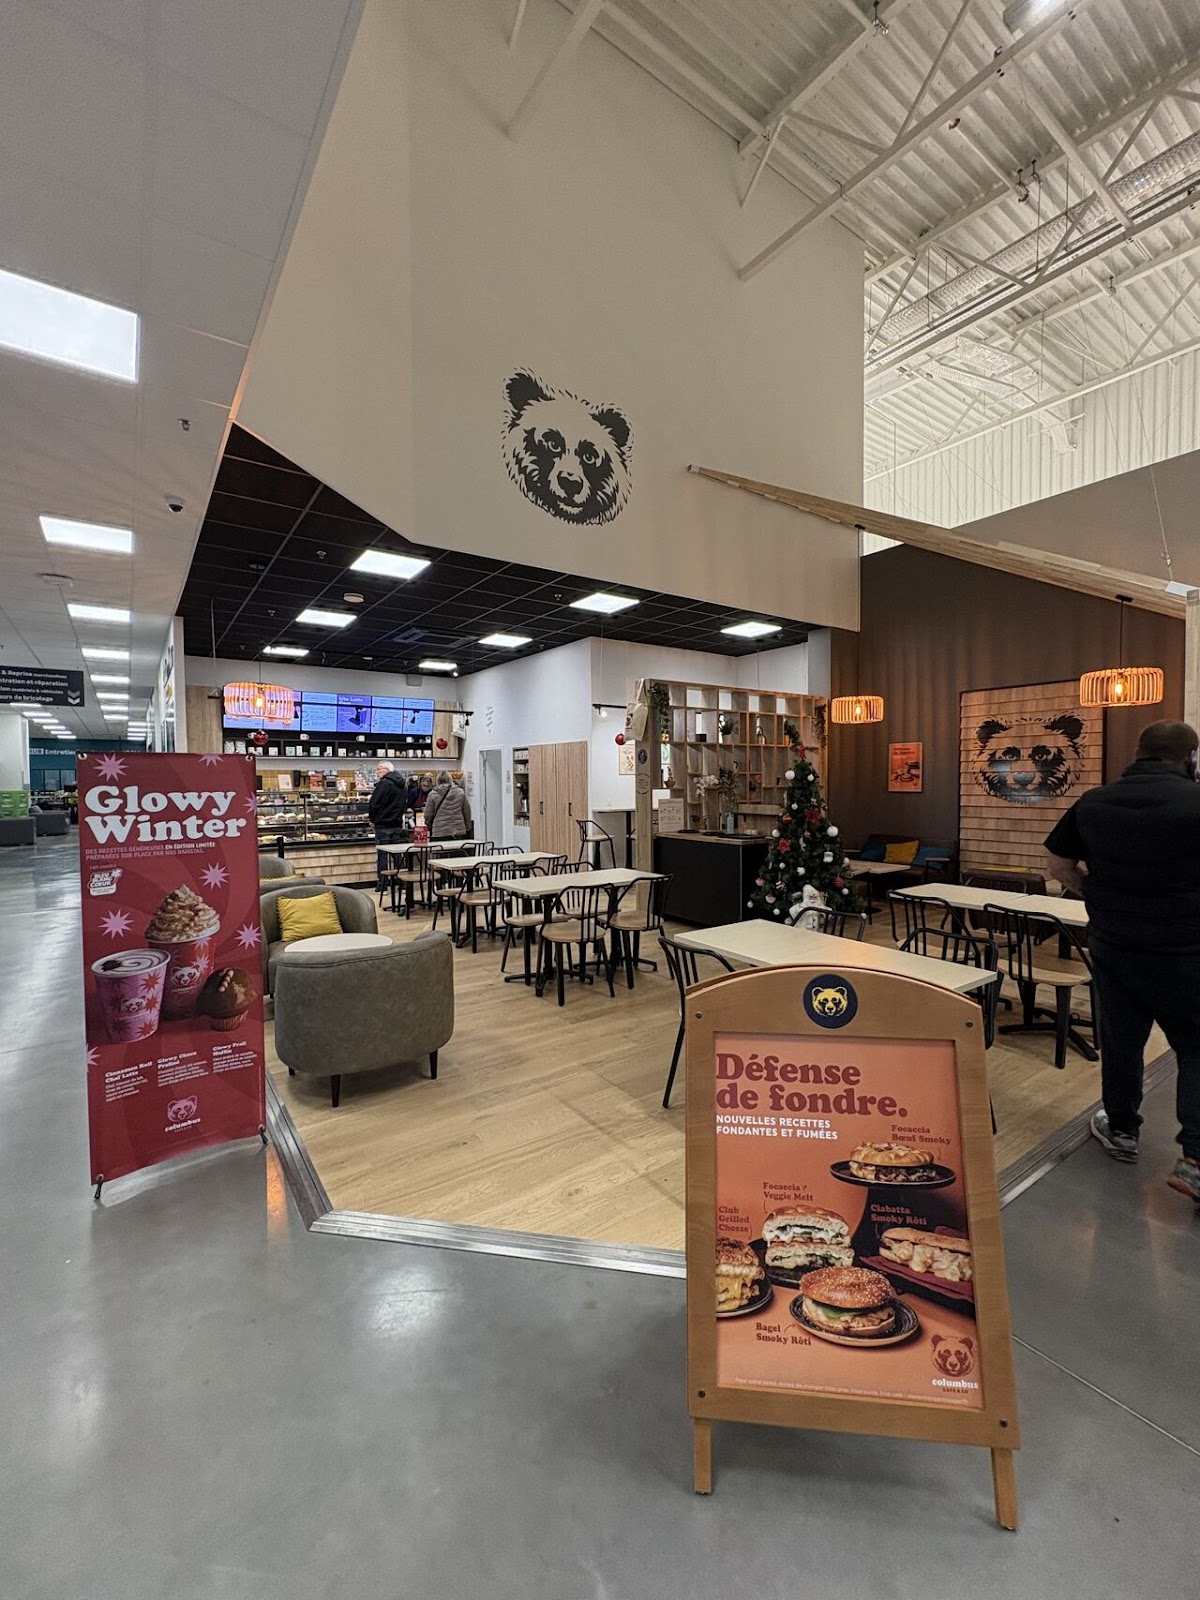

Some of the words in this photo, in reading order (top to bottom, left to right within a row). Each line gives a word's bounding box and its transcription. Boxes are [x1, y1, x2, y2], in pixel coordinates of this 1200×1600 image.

[85, 785, 236, 816] Glowy
[85, 815, 247, 844] Winter
[716, 1053, 861, 1085] Défense
[716, 1082, 759, 1110] de
[769, 1084, 908, 1117] fondre.
[164, 1118, 201, 1132] columbus
[716, 1115, 776, 1126] NOUVELLES
[779, 1117, 831, 1129] RECETTES
[716, 1126, 778, 1137] FONDANTES
[781, 1127, 793, 1137] ET
[796, 1128, 838, 1140] FUMÉES
[891, 1125, 931, 1134] Focaccia
[919, 1135, 952, 1145] Smoky
[763, 1182, 801, 1191] Focaccia
[763, 1191, 791, 1201] Veggie
[794, 1193, 814, 1201] Melt
[719, 1206, 739, 1214] Club
[870, 1204, 911, 1213] Ciabatta
[719, 1214, 750, 1223] Grilled
[870, 1213, 904, 1224] Smoky
[906, 1216, 927, 1225] Rôti
[719, 1224, 749, 1232] Cheese
[756, 1322, 781, 1333] Bagel
[756, 1333, 788, 1345] Smoky
[791, 1336, 811, 1346] Rôti
[931, 1378, 979, 1389] columbus
